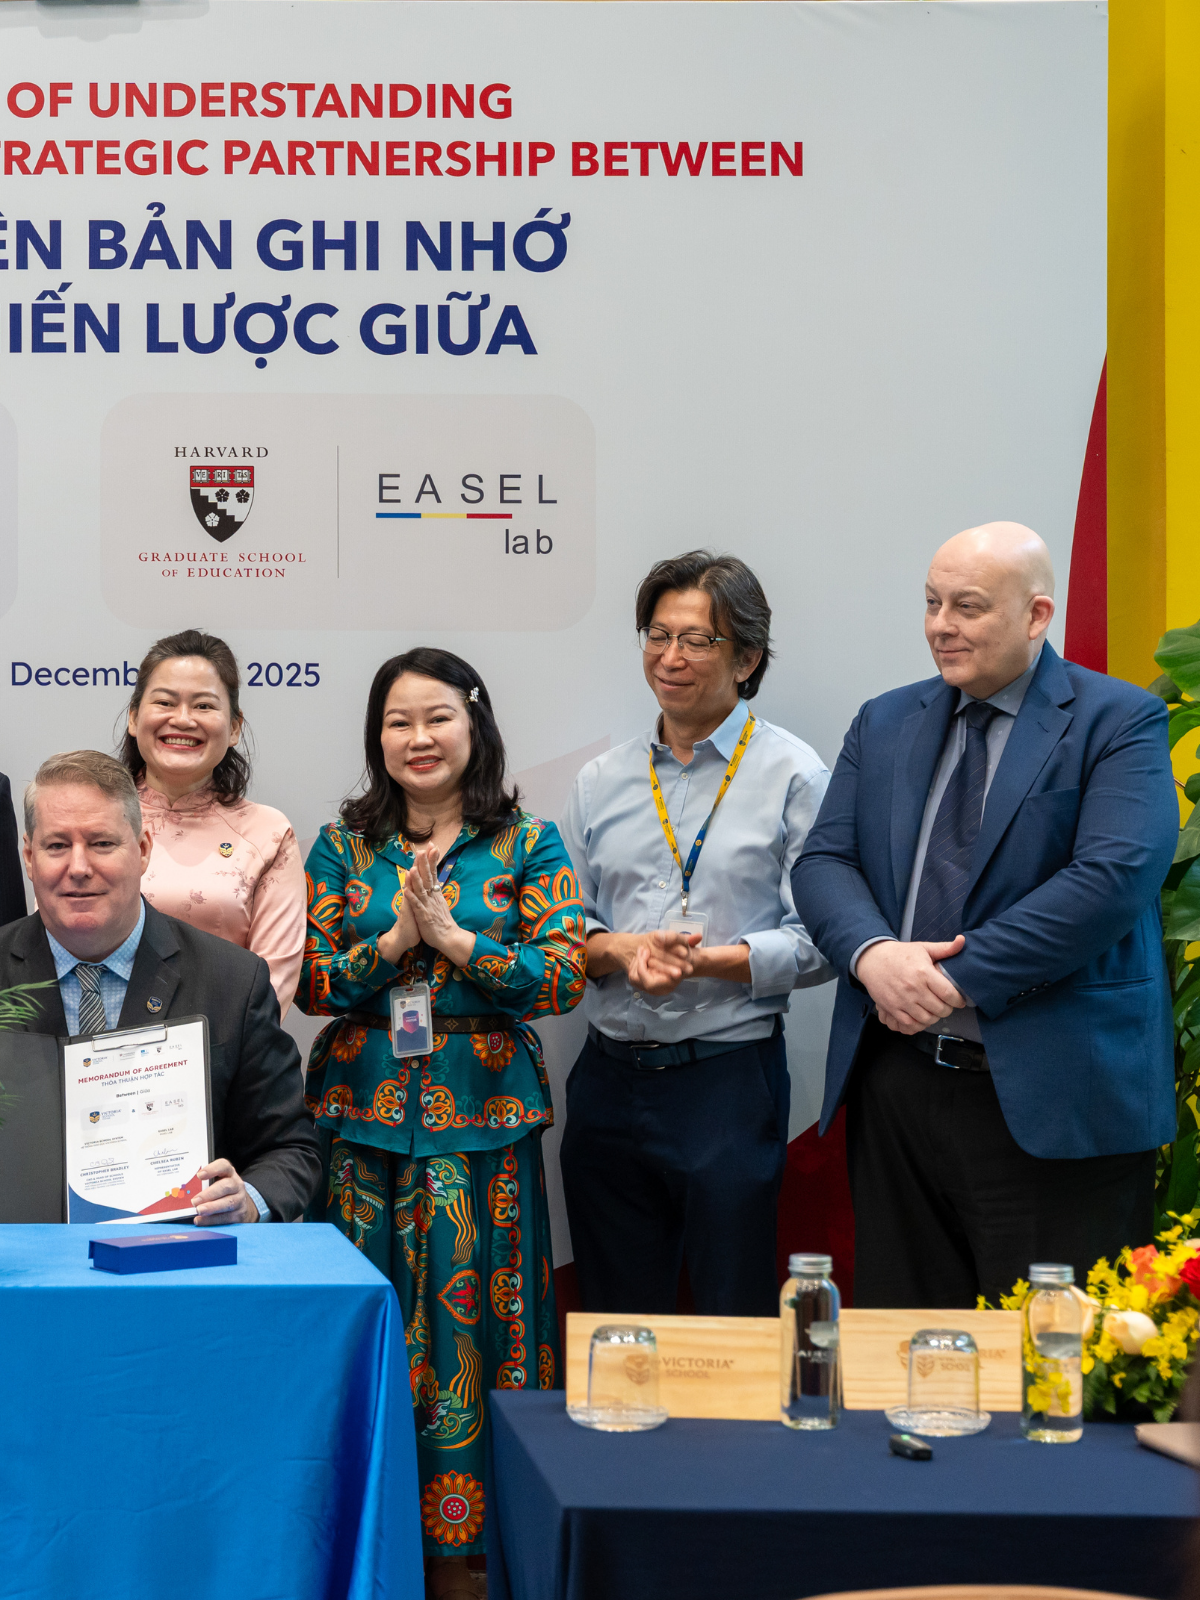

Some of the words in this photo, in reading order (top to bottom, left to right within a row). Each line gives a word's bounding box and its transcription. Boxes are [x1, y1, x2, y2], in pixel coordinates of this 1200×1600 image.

[6, 81, 74, 119] OF
[88, 81, 513, 120] UNDERSTANDING
[223, 139, 556, 178] PARTNERSHIP
[571, 141, 804, 177] BETWEEN
[88, 201, 233, 270] BẢN
[256, 218, 380, 272] GHI
[405, 207, 572, 273] NHỚ
[146, 291, 340, 370] LƯỢC
[359, 290, 539, 357] GIỮA
[174, 446, 269, 458] HARVARD
[378, 473, 558, 505] EASEL
[505, 528, 553, 555] lab
[138, 552, 229, 563] GRADUATE
[238, 552, 307, 563] SCHOOL
[161, 569, 179, 578] OF
[187, 567, 286, 578] EDUCATION
[10, 660, 139, 688] Decemb
[246, 661, 321, 688] 2025
[78, 1070, 130, 1084] MEMORANDUM
[144, 1060, 188, 1072] AGREEMENT
